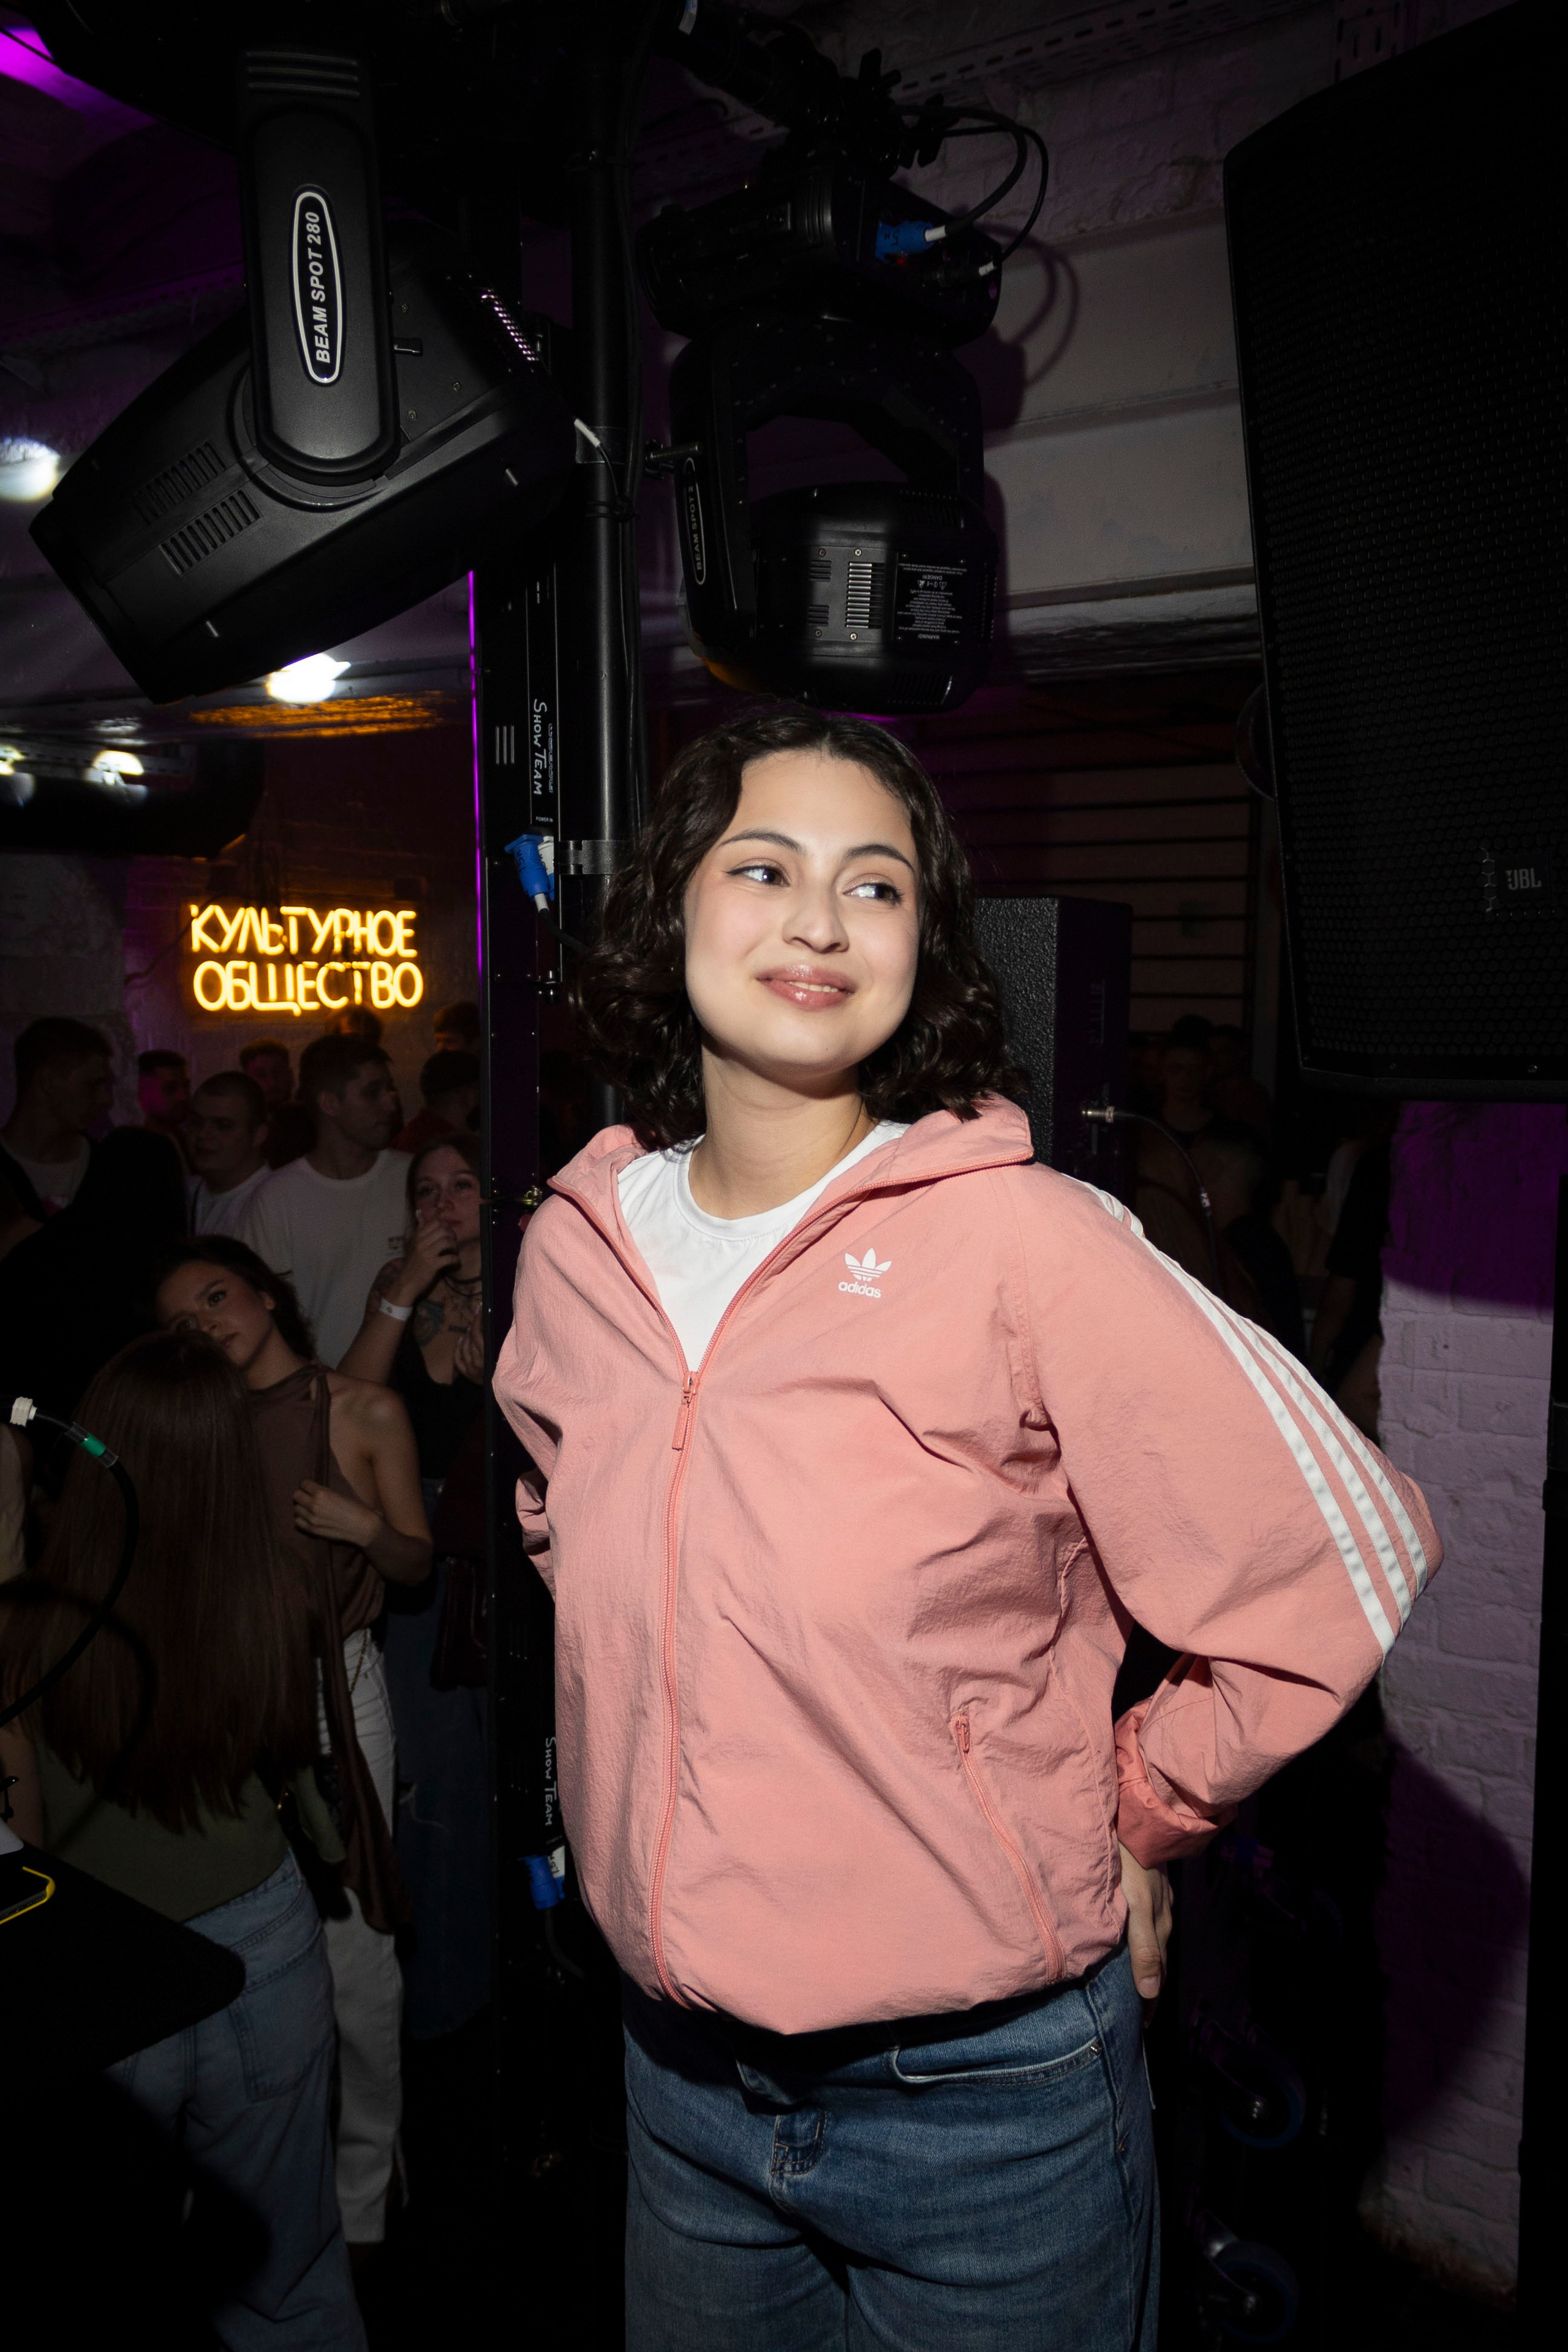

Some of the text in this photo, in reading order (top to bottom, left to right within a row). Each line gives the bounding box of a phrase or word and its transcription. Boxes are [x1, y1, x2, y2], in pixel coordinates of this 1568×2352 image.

[305, 211, 331, 364] BEAM SPOT 280
[688, 494, 698, 532] SPOT
[692, 533, 703, 571] BEAM
[1505, 867, 1542, 891] JBL
[188, 903, 418, 959] КУЛЬТУРНОЕ
[192, 959, 424, 1017] ОБЩЕСТВО
[838, 1281, 881, 1298] adidas
